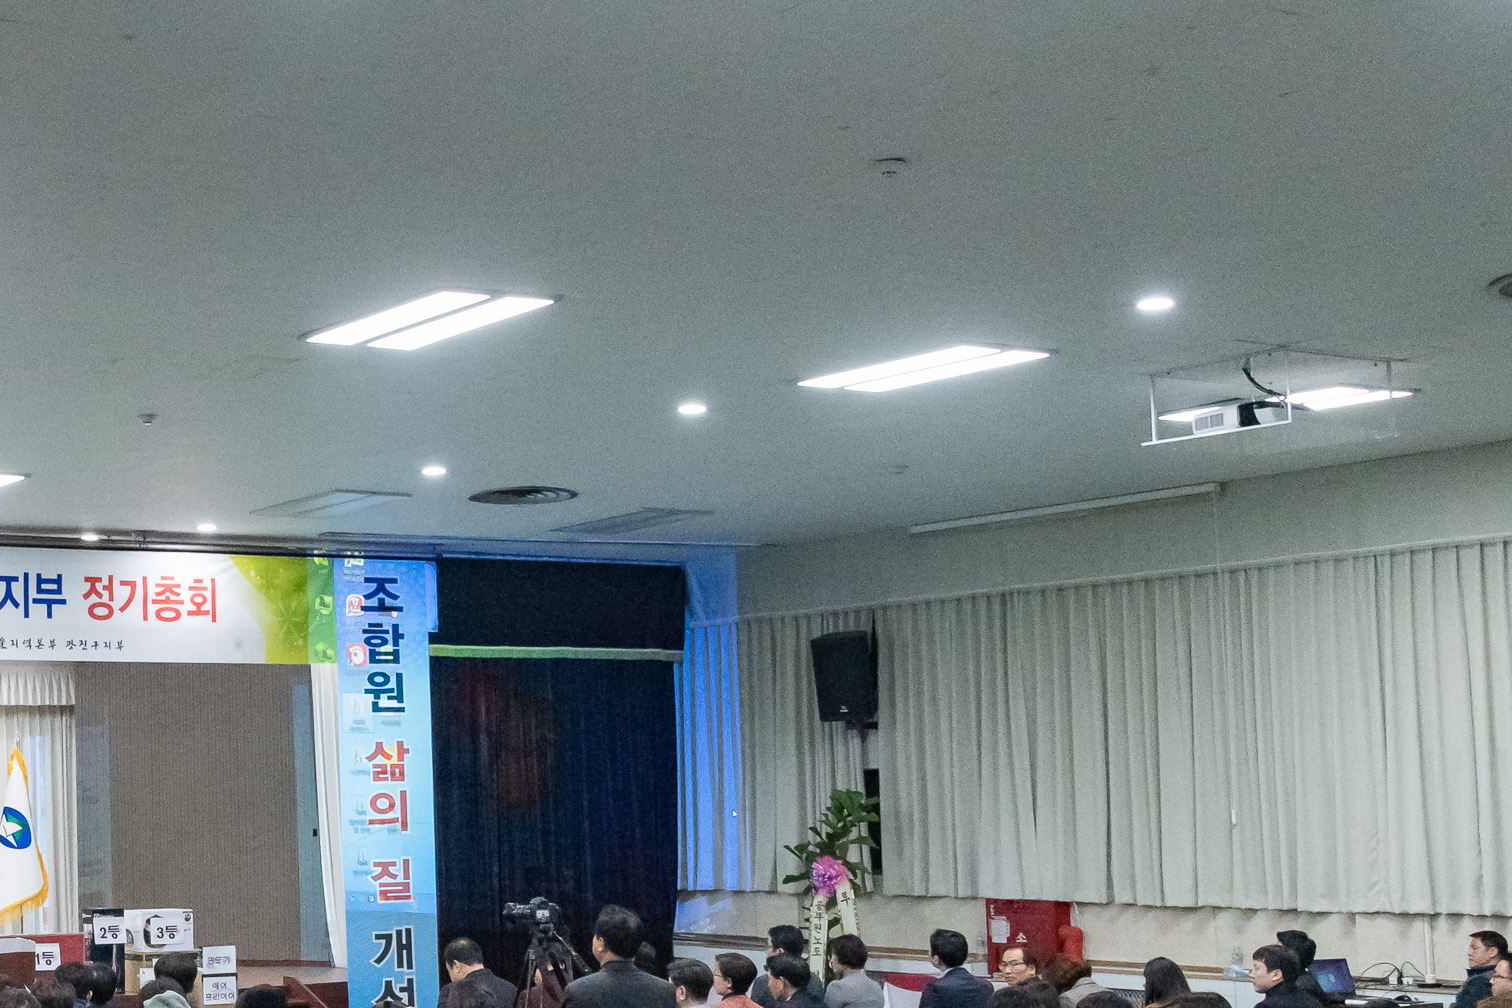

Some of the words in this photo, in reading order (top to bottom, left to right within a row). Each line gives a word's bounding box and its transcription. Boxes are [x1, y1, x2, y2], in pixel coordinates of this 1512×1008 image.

[82, 573, 217, 622] 정기총회
[66, 639, 124, 651] 광진구지부
[361, 577, 406, 713] 조합원
[365, 740, 409, 832] 삶의
[372, 858, 412, 901] 질
[99, 925, 120, 939] 2등
[156, 925, 178, 939] 3등
